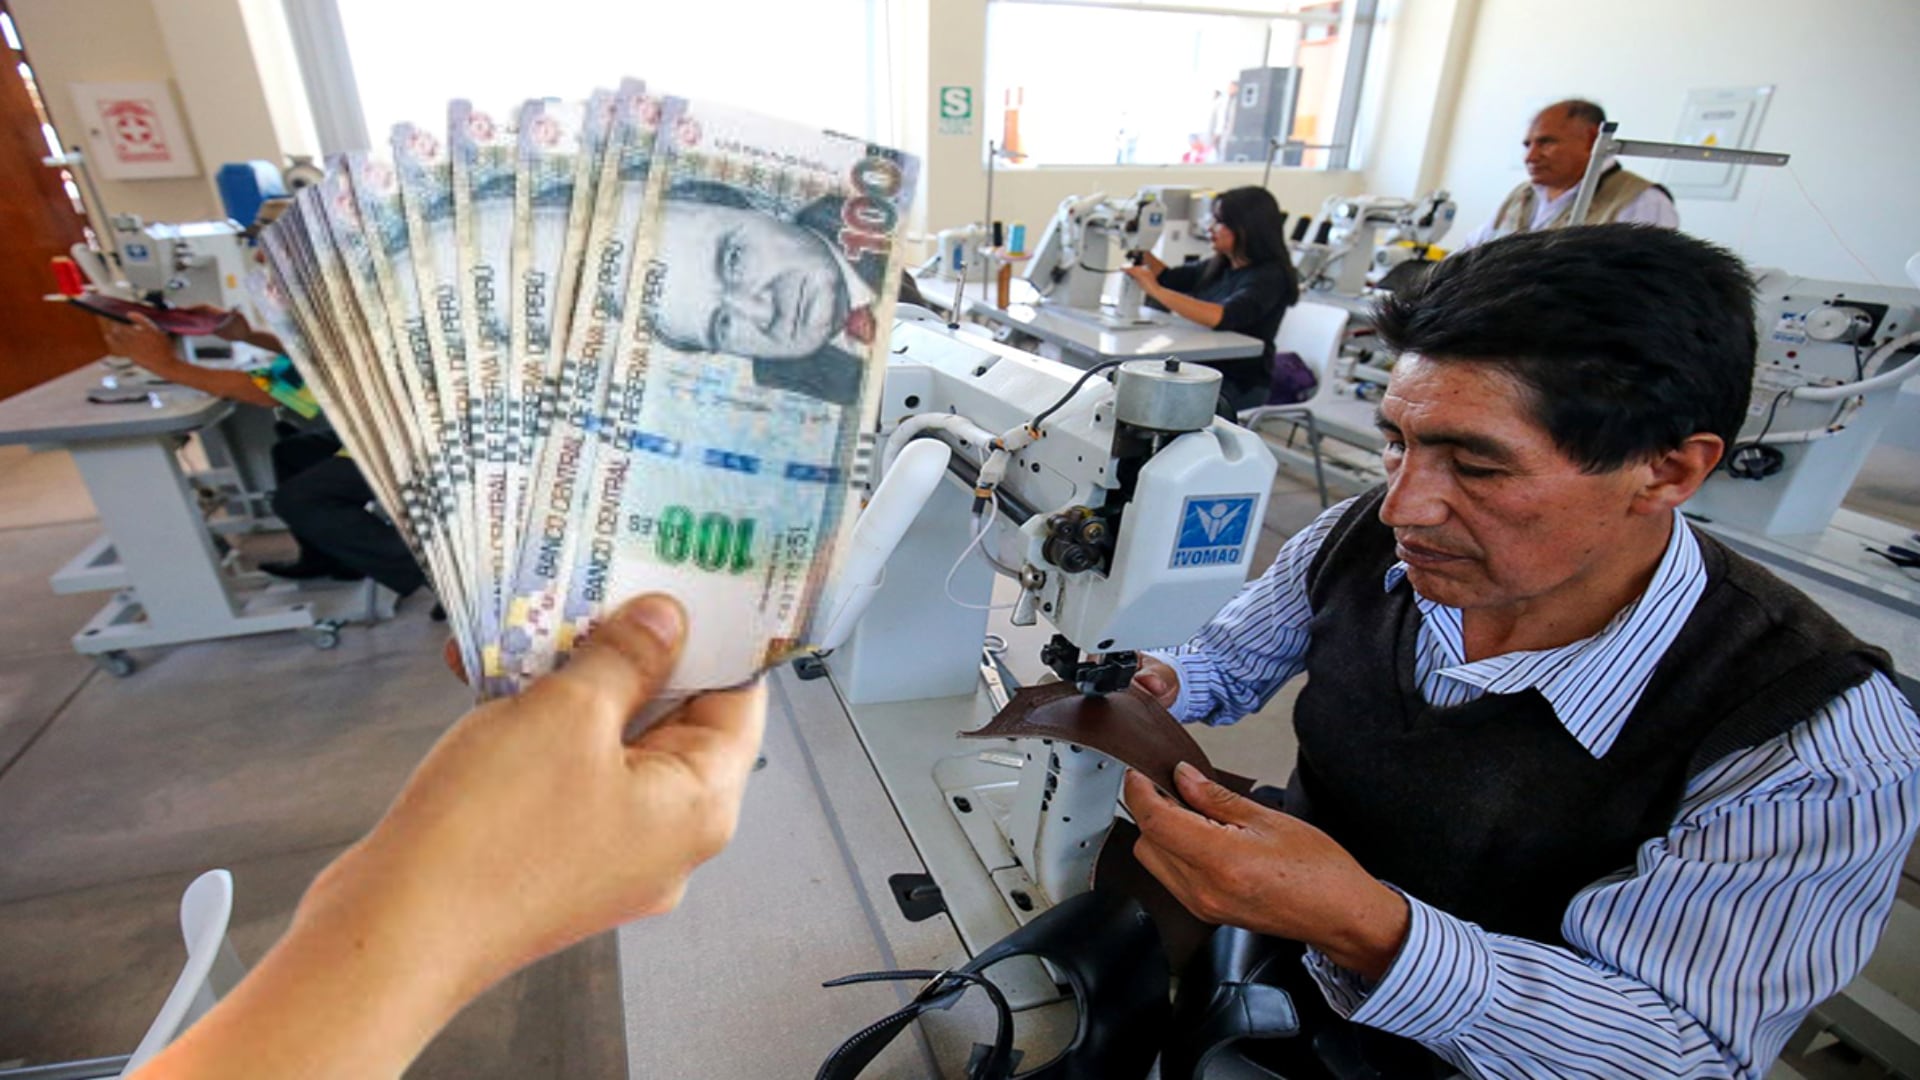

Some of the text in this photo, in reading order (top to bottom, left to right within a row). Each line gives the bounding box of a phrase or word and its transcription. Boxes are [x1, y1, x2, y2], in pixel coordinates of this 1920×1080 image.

[944, 88, 968, 116] S
[838, 156, 900, 262] 100
[481, 357, 505, 433] RESERVA
[575, 326, 605, 400] RESERVA
[618, 347, 649, 424] RESERVA
[569, 403, 589, 428] DE
[613, 426, 634, 451] DE
[487, 440, 506, 462] DE
[550, 434, 584, 512] CENTRAL
[597, 456, 630, 536] CENTRAL
[536, 516, 565, 578] BANCO
[583, 539, 611, 602] BANCO
